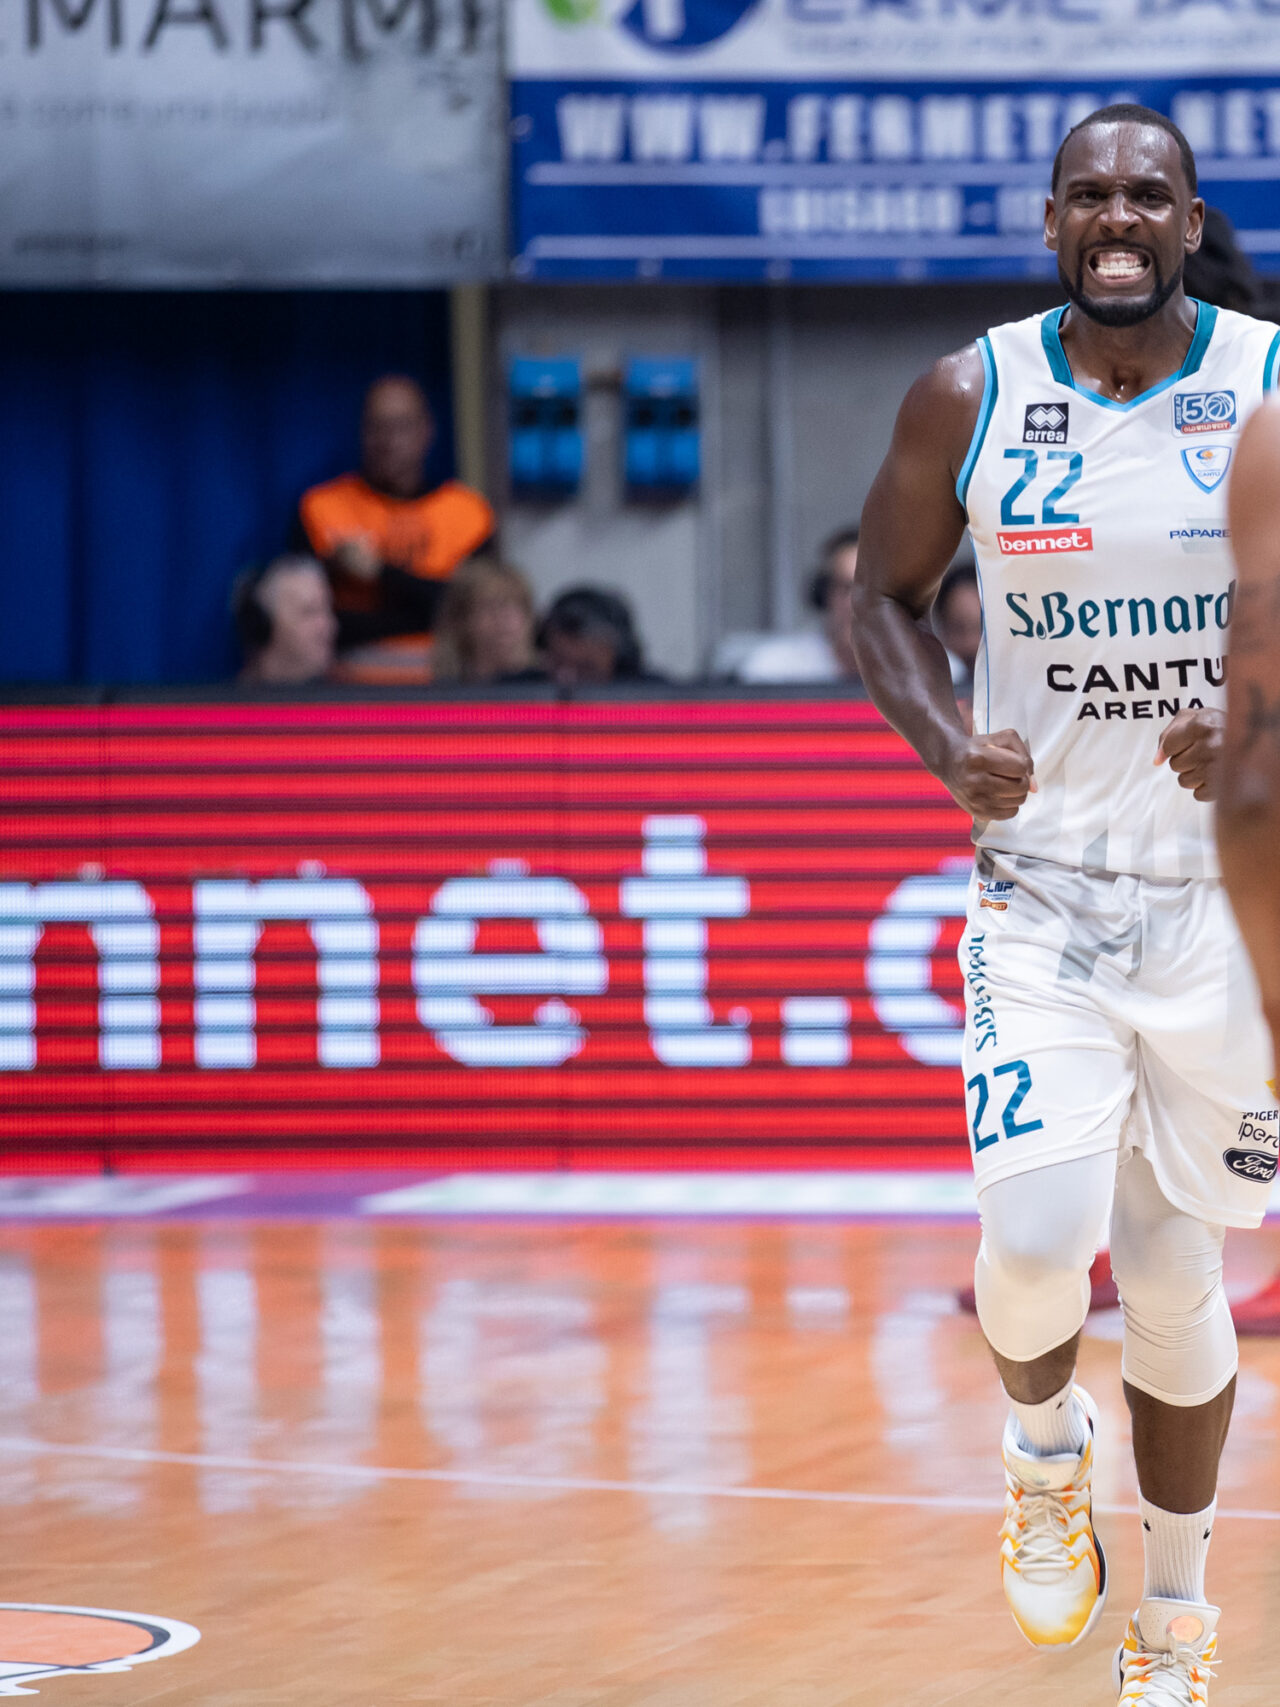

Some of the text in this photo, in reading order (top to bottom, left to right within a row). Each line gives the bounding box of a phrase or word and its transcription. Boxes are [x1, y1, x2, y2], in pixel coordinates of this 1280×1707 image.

[1001, 449, 1083, 525] 22
[1000, 532, 1088, 552] bennet
[967, 1059, 1044, 1154] 22
[1232, 1154, 1275, 1179] Ford
